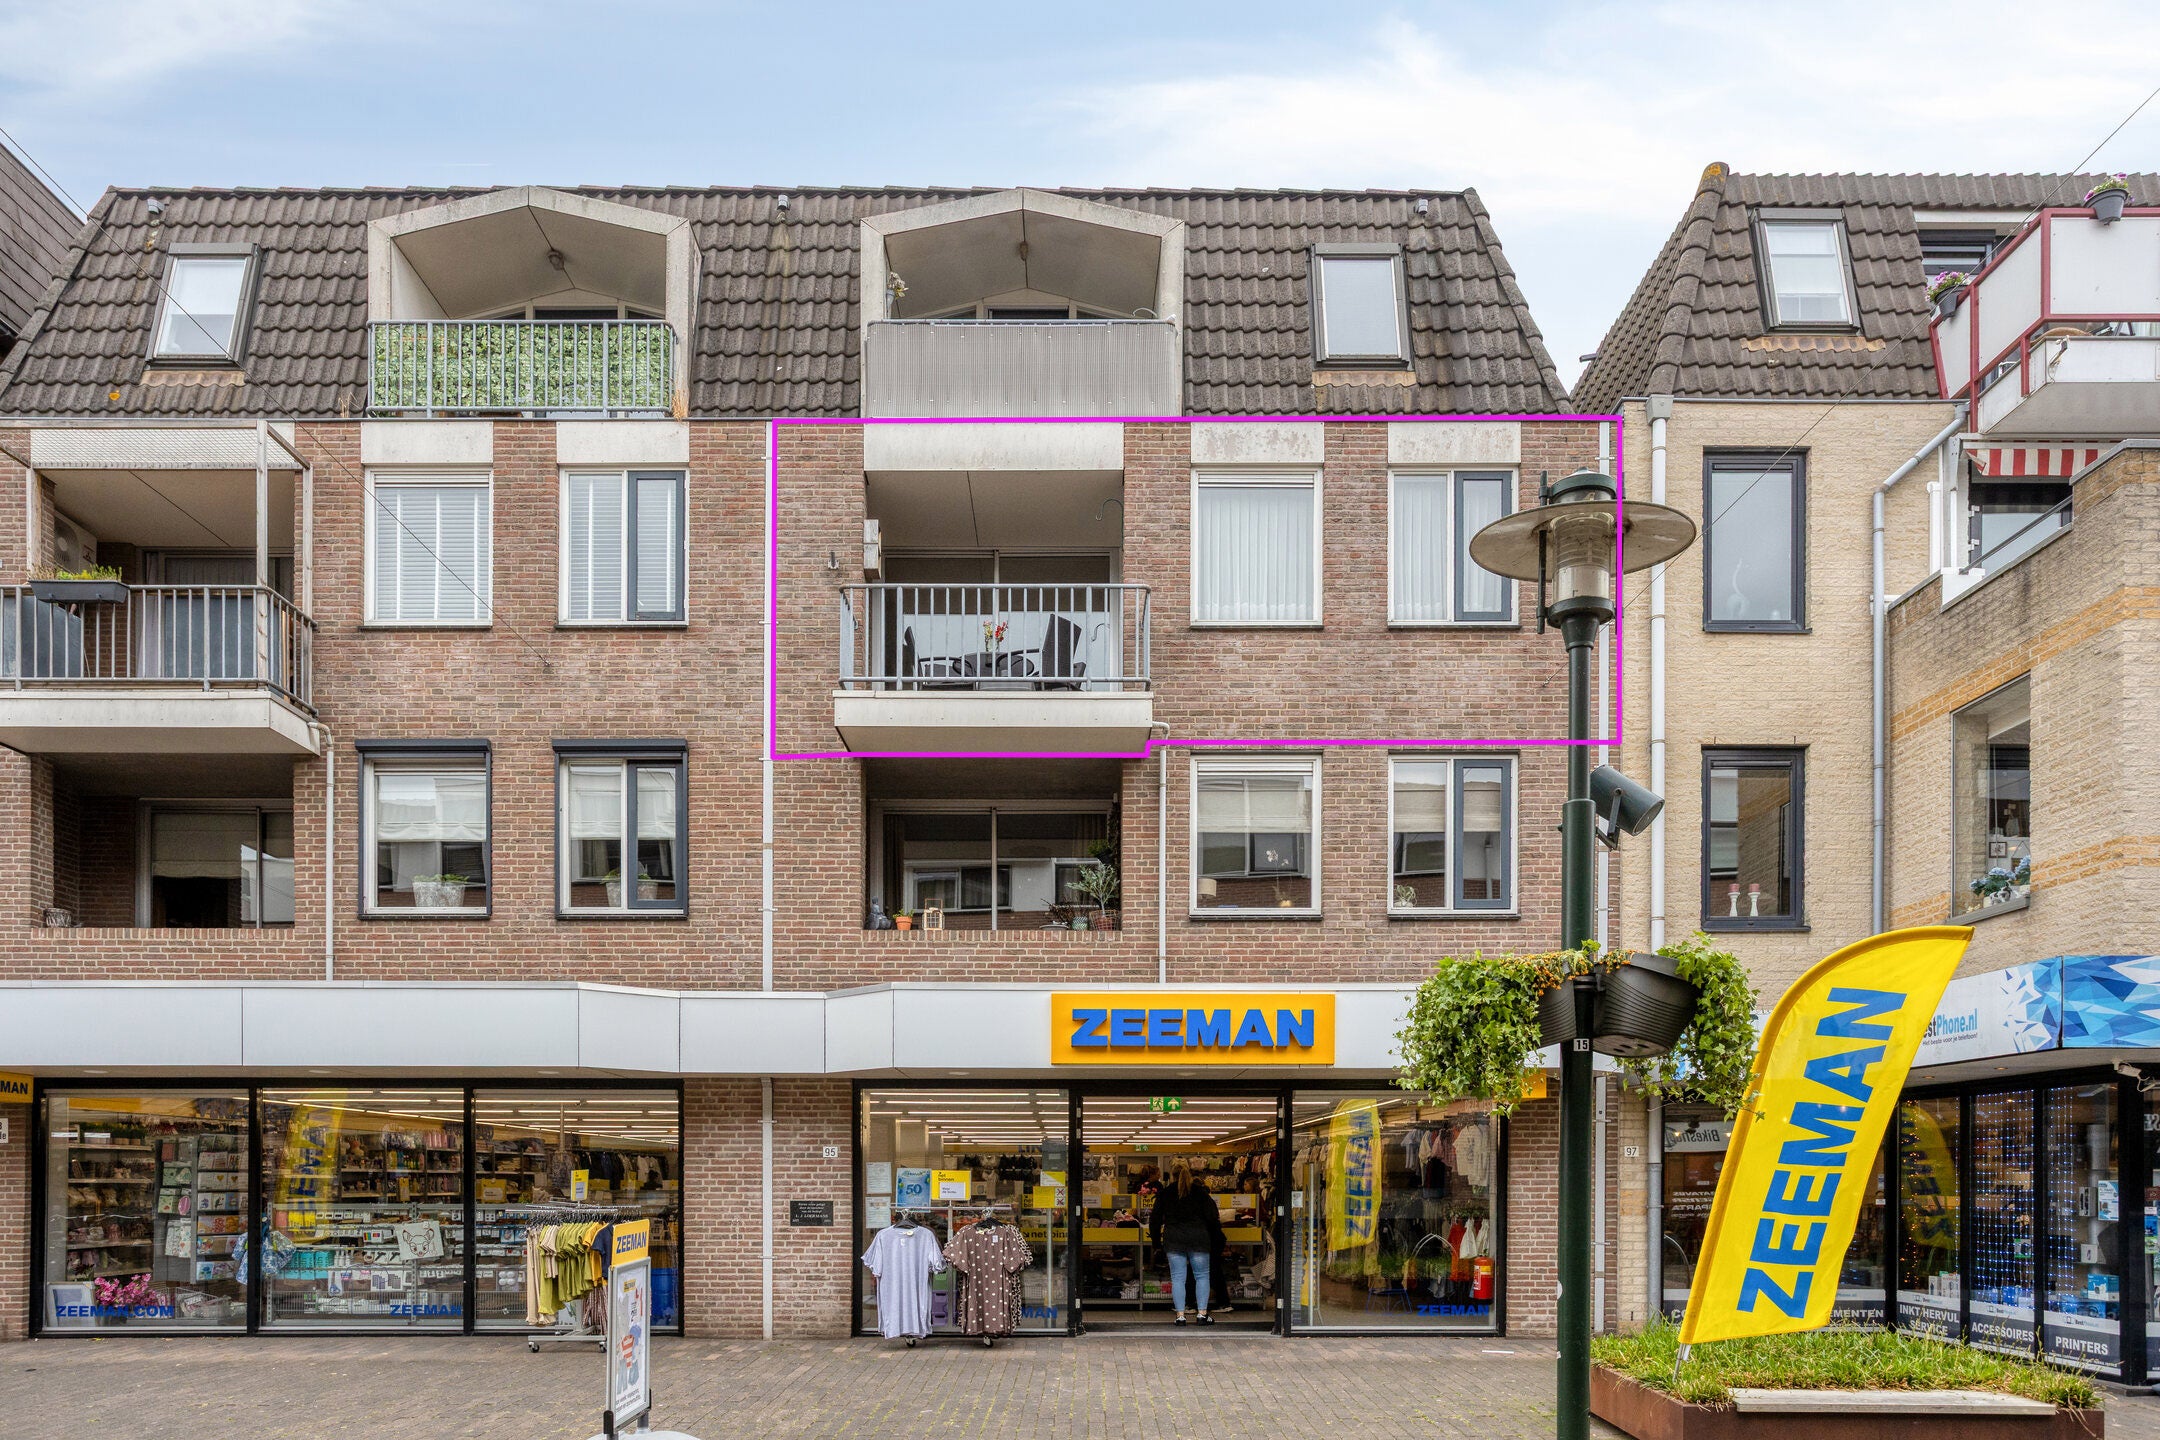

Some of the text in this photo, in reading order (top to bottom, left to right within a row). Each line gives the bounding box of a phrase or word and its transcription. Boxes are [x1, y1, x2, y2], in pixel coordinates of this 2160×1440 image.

[1071, 1008, 1315, 1048] ZEEMAN
[1576, 1040, 1588, 1050] 15
[824, 1147, 836, 1157] 95
[1626, 1147, 1637, 1156] 97
[1737, 987, 1907, 1319] ZEEMAN
[906, 1183, 922, 1195] 50
[1031, 1230, 1047, 1238] net
[616, 1232, 648, 1255] ZEEMAN
[56, 1305, 175, 1318] ZEEMAN.COM
[389, 1304, 463, 1317] ZEEMAN
[1021, 1305, 1058, 1319] MAN
[1417, 1304, 1490, 1317] ZEEMAN
[1899, 1303, 1960, 1324] INKT HERVUL
[1909, 1319, 1949, 1336] SERVICE
[1971, 1321, 2035, 1342] ACCESSOIRES
[2055, 1335, 2109, 1355] PRINTERS
